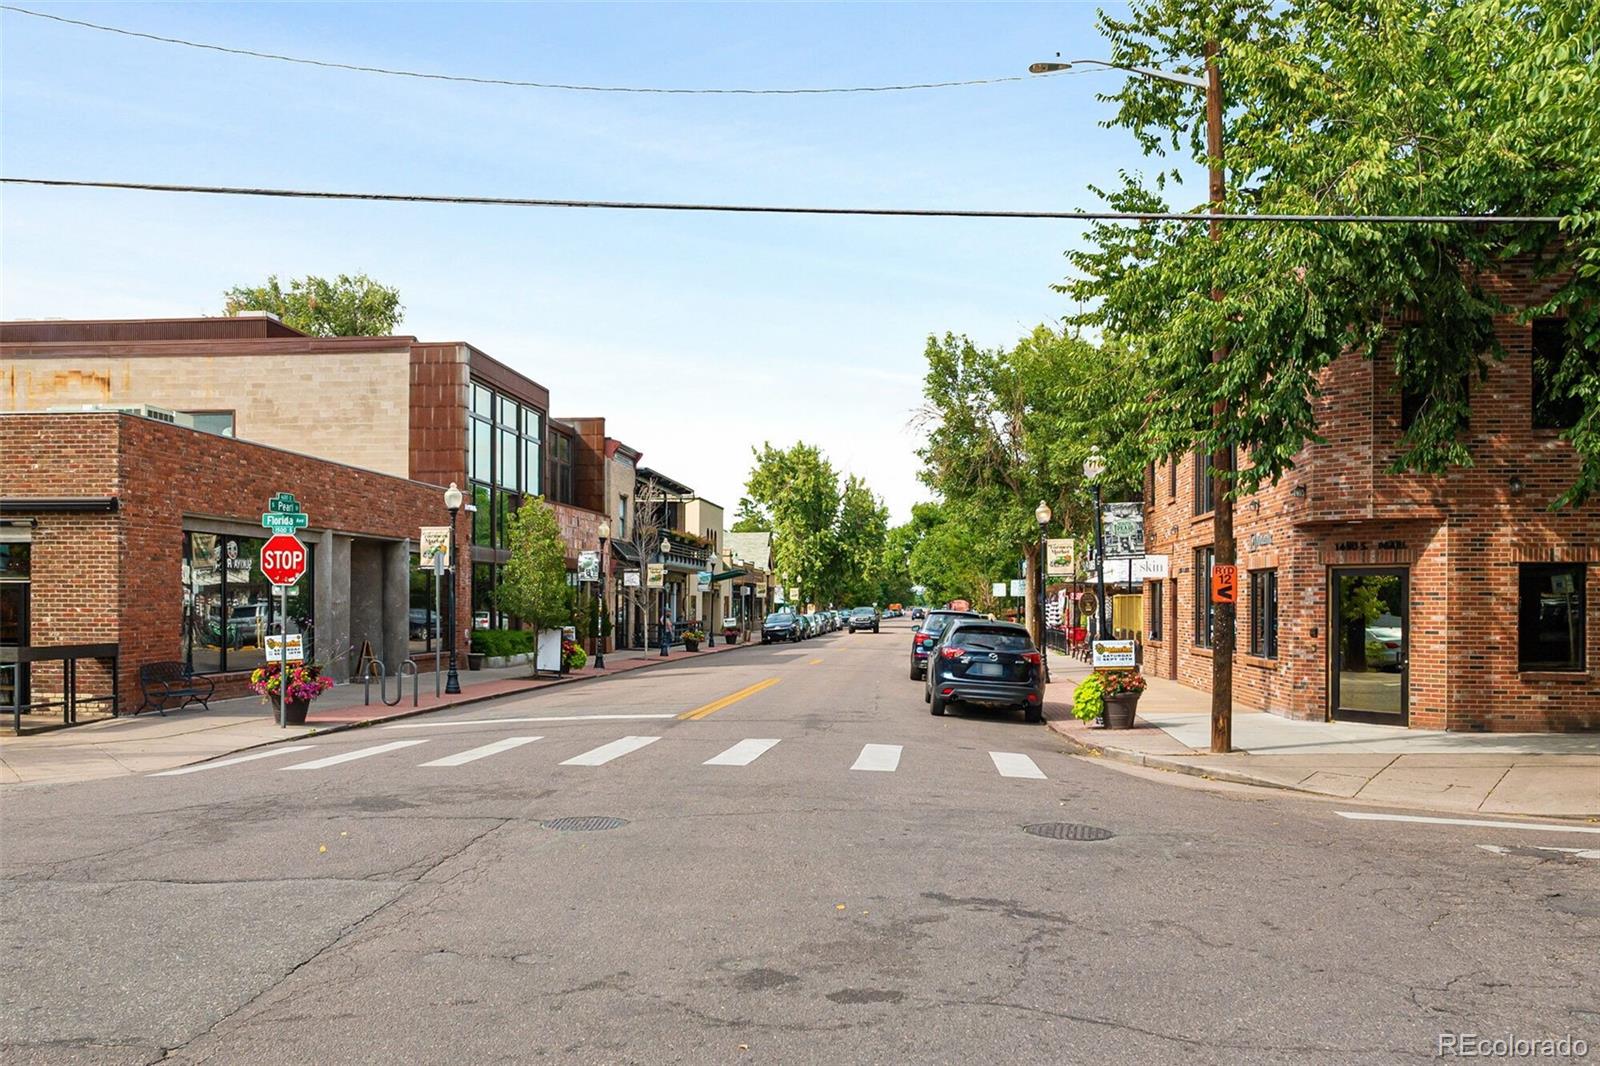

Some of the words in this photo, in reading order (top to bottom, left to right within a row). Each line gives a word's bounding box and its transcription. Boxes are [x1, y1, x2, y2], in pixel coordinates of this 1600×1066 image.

[278, 501, 294, 511] Pearl
[266, 515, 294, 526] Florida
[264, 550, 303, 570] STOP
[1139, 560, 1164, 572] skin
[1215, 566, 1235, 575] RTD
[1219, 574, 1232, 585] 12
